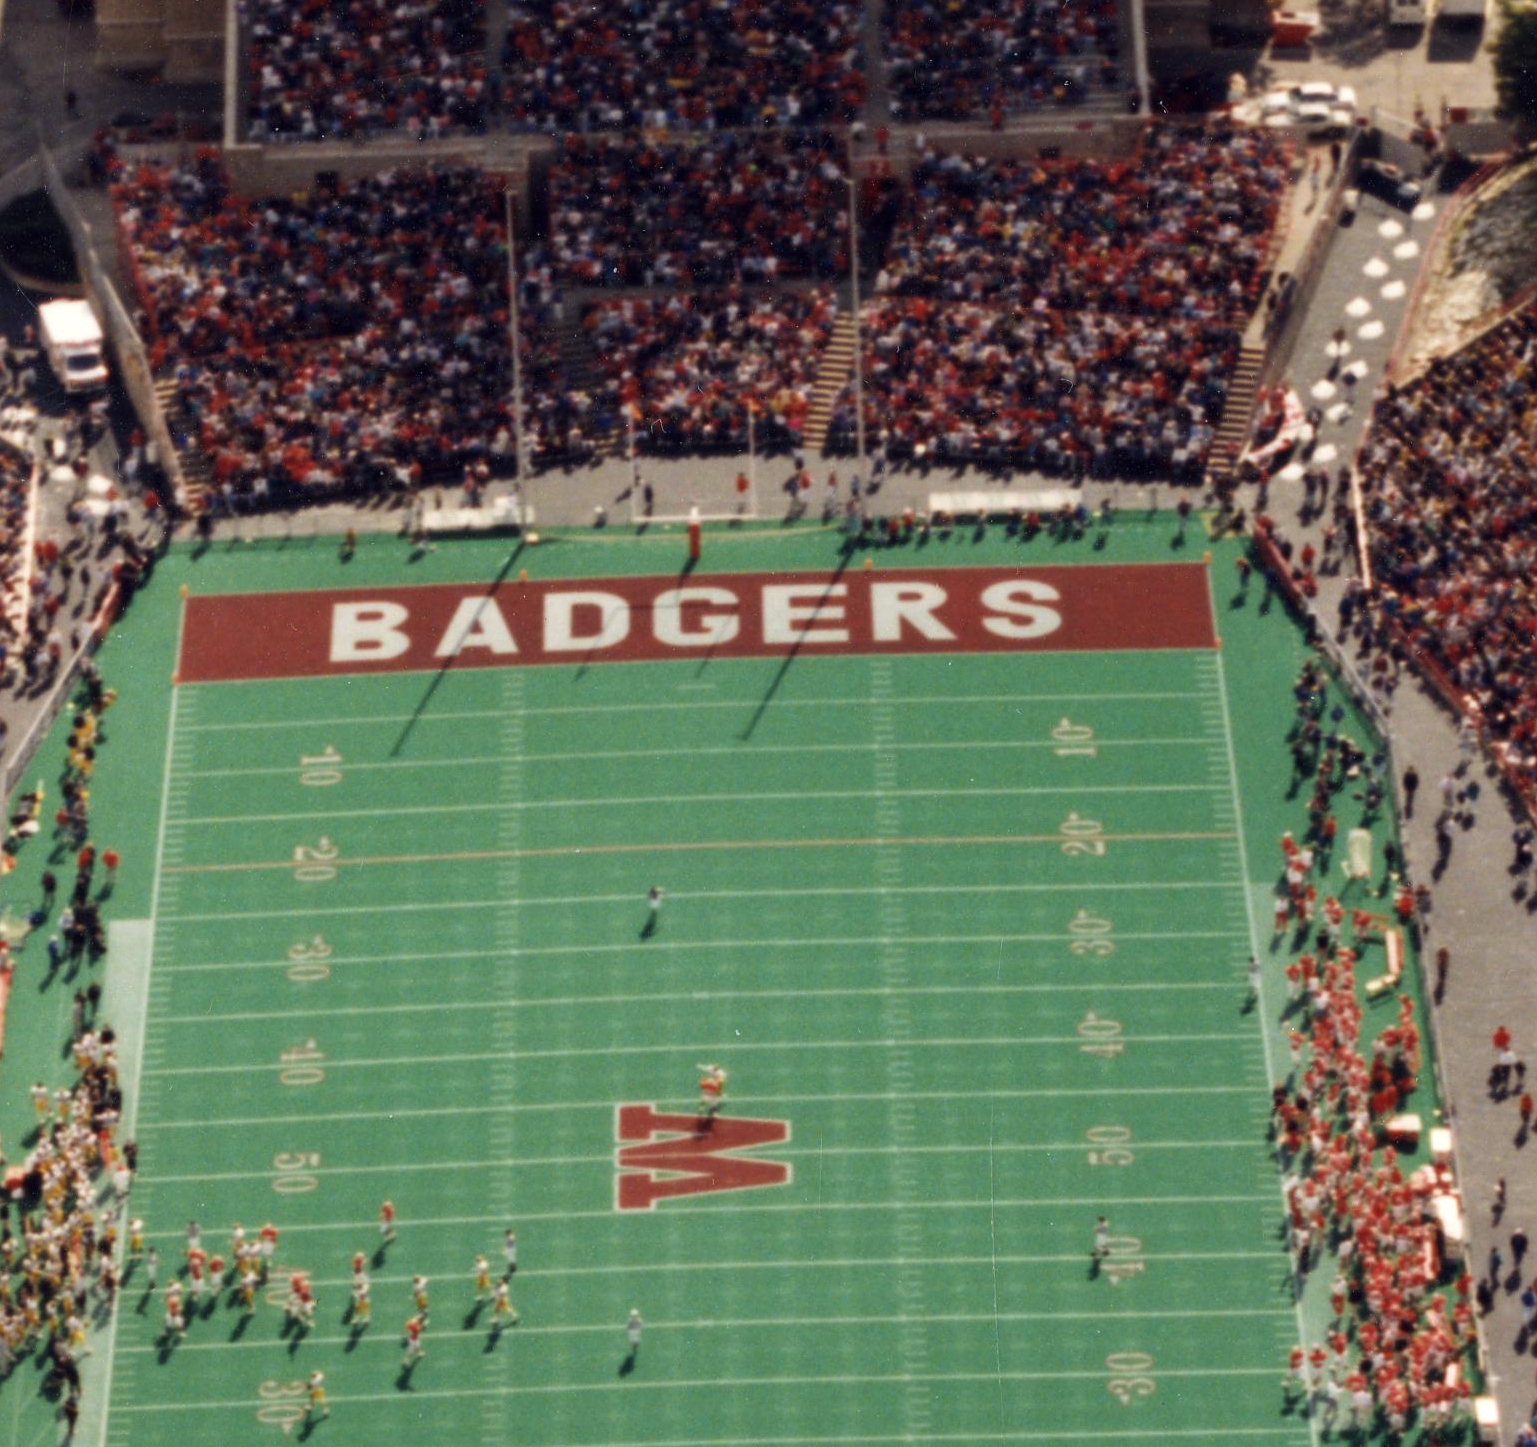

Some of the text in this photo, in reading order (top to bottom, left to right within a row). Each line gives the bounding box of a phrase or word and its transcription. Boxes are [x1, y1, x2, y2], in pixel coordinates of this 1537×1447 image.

[329, 578, 1063, 664] BADGERS
[1051, 724, 1097, 758] 10
[299, 748, 343, 787] 10
[1060, 817, 1106, 858] 20
[292, 839, 338, 882] 20
[1069, 916, 1115, 957] 30
[287, 938, 332, 982] 30
[1078, 1017, 1124, 1059] 40
[279, 1042, 327, 1087] 40
[614, 1103, 792, 1214] W
[1087, 1125, 1134, 1167] 50
[273, 1151, 320, 1193] 50
[1106, 1351, 1154, 1397] 30
[256, 1381, 304, 1424] 30
